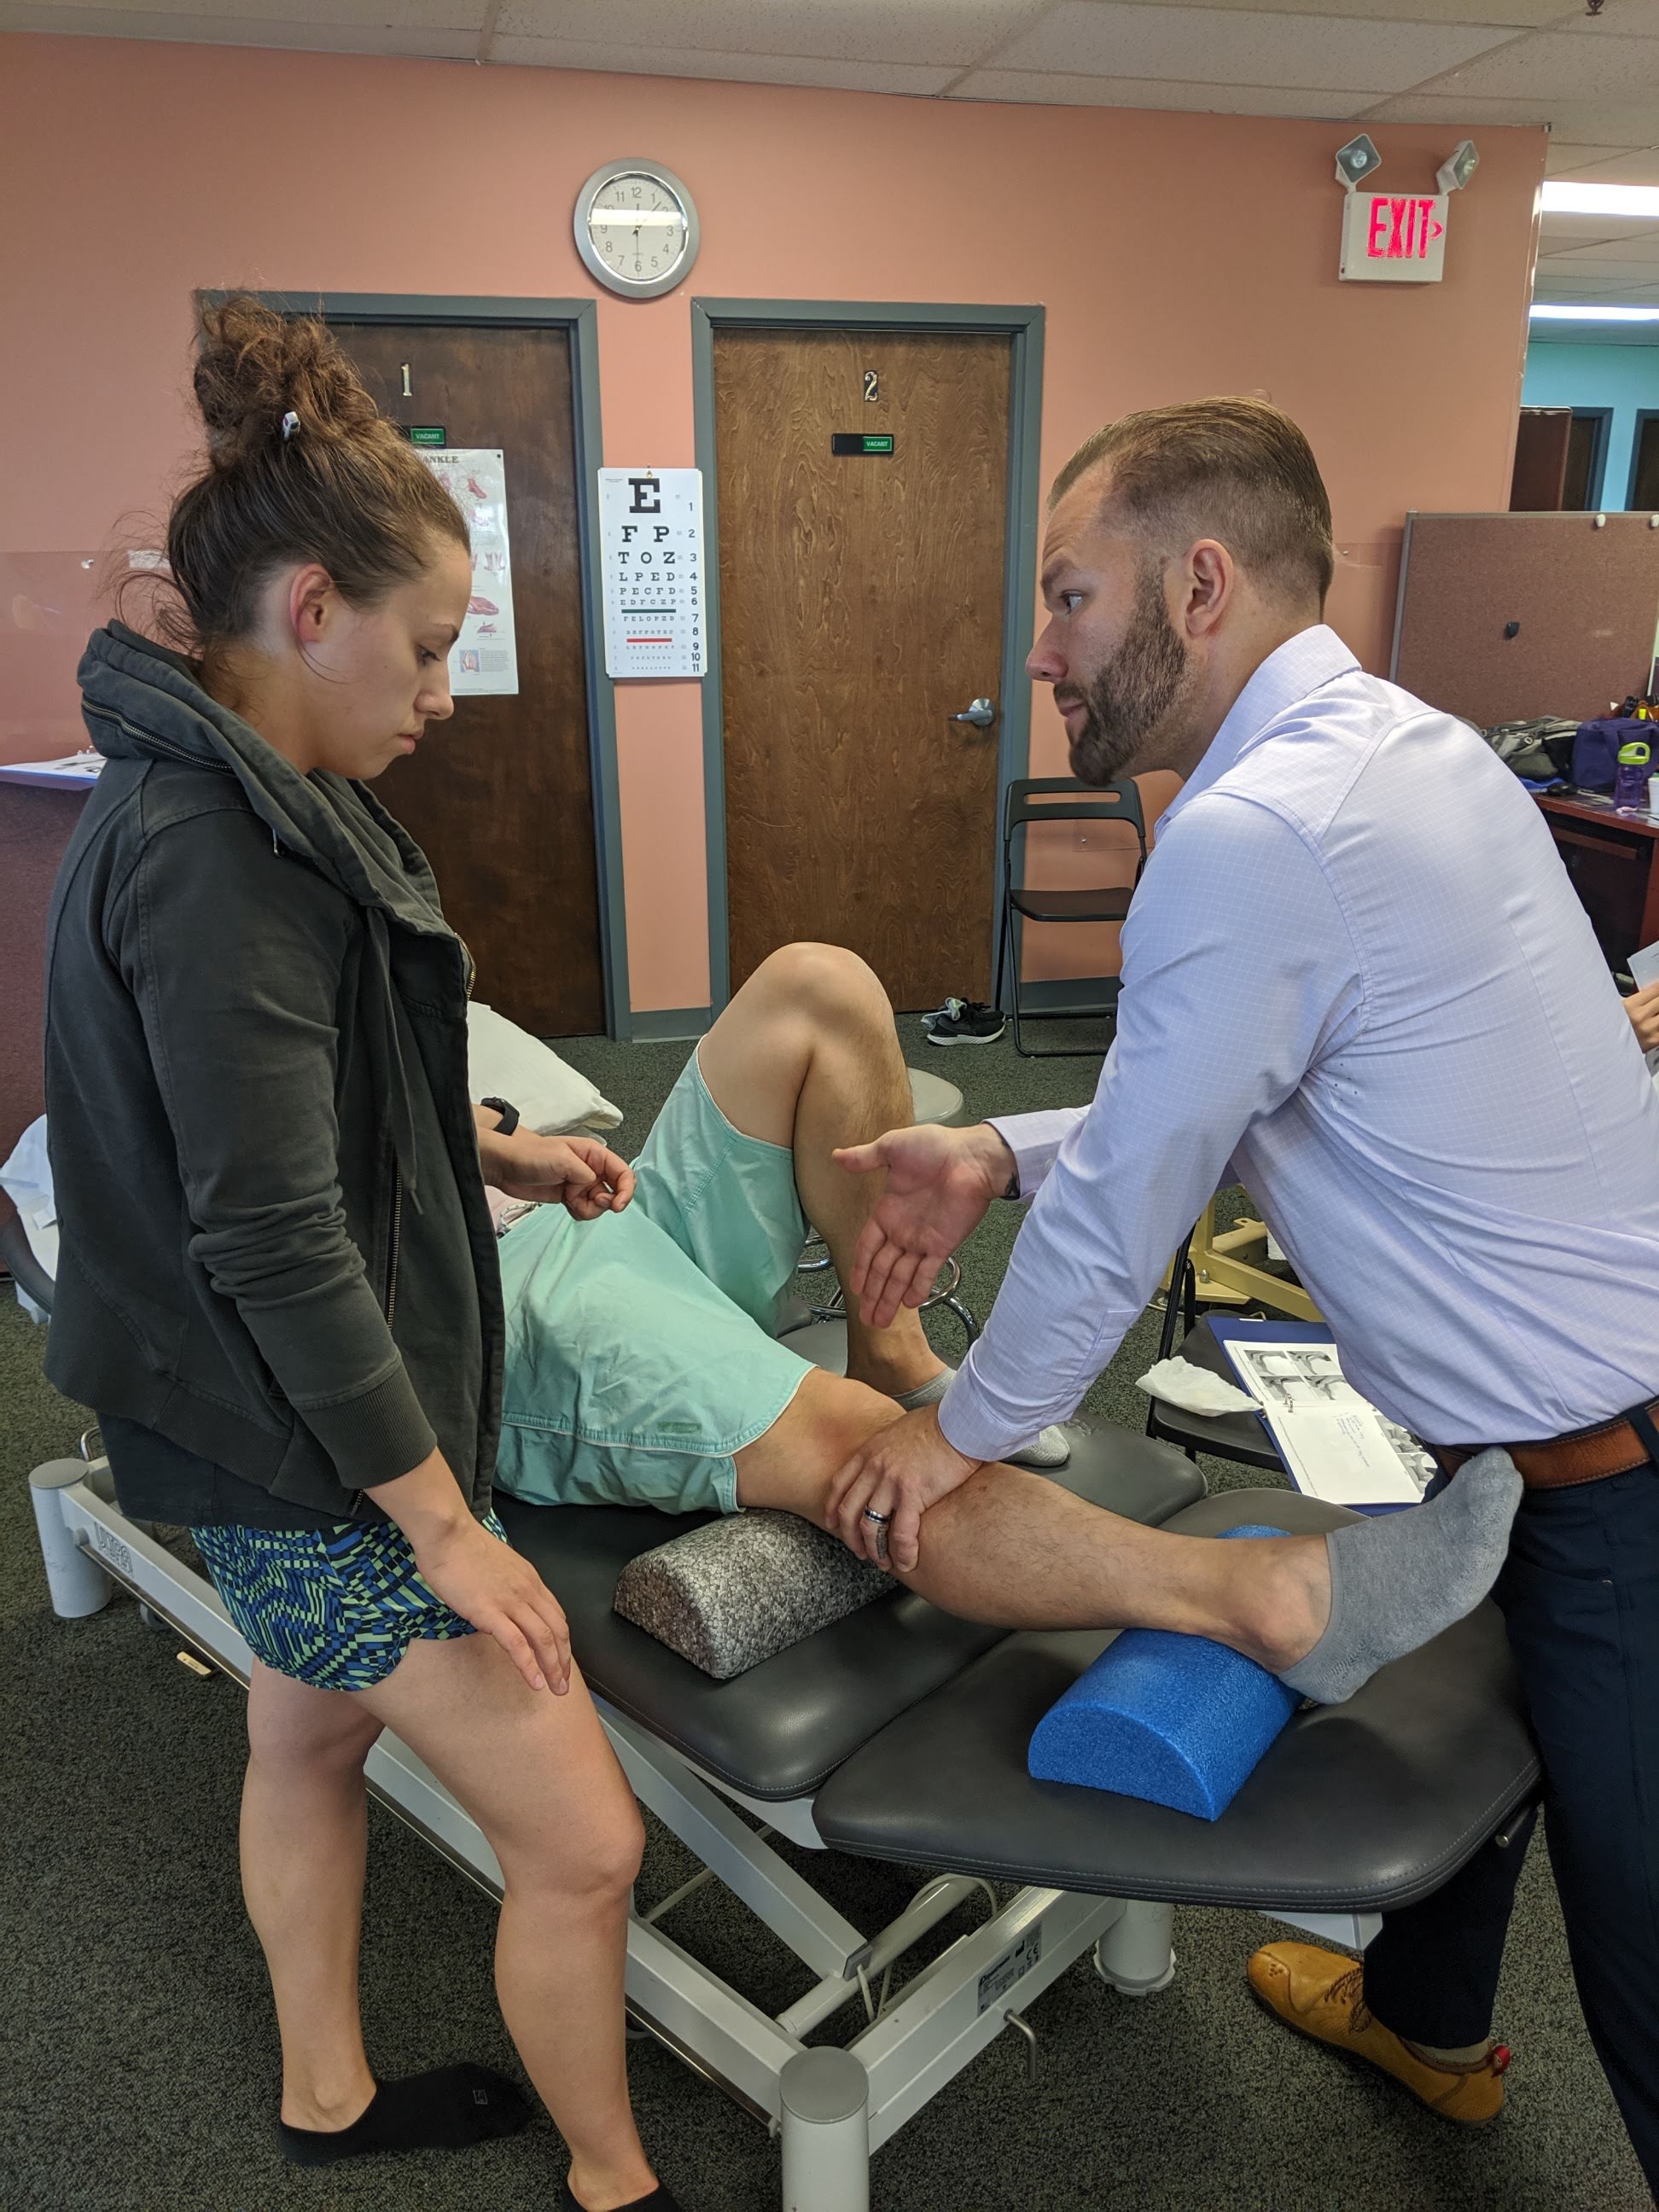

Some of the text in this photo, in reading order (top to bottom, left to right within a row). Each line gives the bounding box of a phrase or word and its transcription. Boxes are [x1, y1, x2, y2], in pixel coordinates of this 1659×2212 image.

[615, 191, 625, 202] 11
[631, 187, 642, 199] 12
[650, 194, 655, 203] 1
[667, 226, 674, 237] 3
[1367, 197, 1435, 259] EXIT
[605, 241, 613, 253] 8
[662, 243, 669, 254] 4
[618, 255, 625, 265] 7
[650, 256, 659, 268] 5
[634, 260, 642, 272] 6
[401, 364, 412, 396] 1
[864, 371, 877, 401] 2
[628, 478, 661, 513] E
[689, 502, 693, 512] 1
[688, 528, 696, 538] 2
[690, 553, 697, 562] 3
[690, 572, 698, 580] 4
[690, 586, 697, 595] 5
[691, 614, 699, 622] 7
[692, 627, 699, 636] 8
[692, 642, 699, 650] 9
[690, 653, 701, 661] 10
[691, 663, 699, 672] 11
